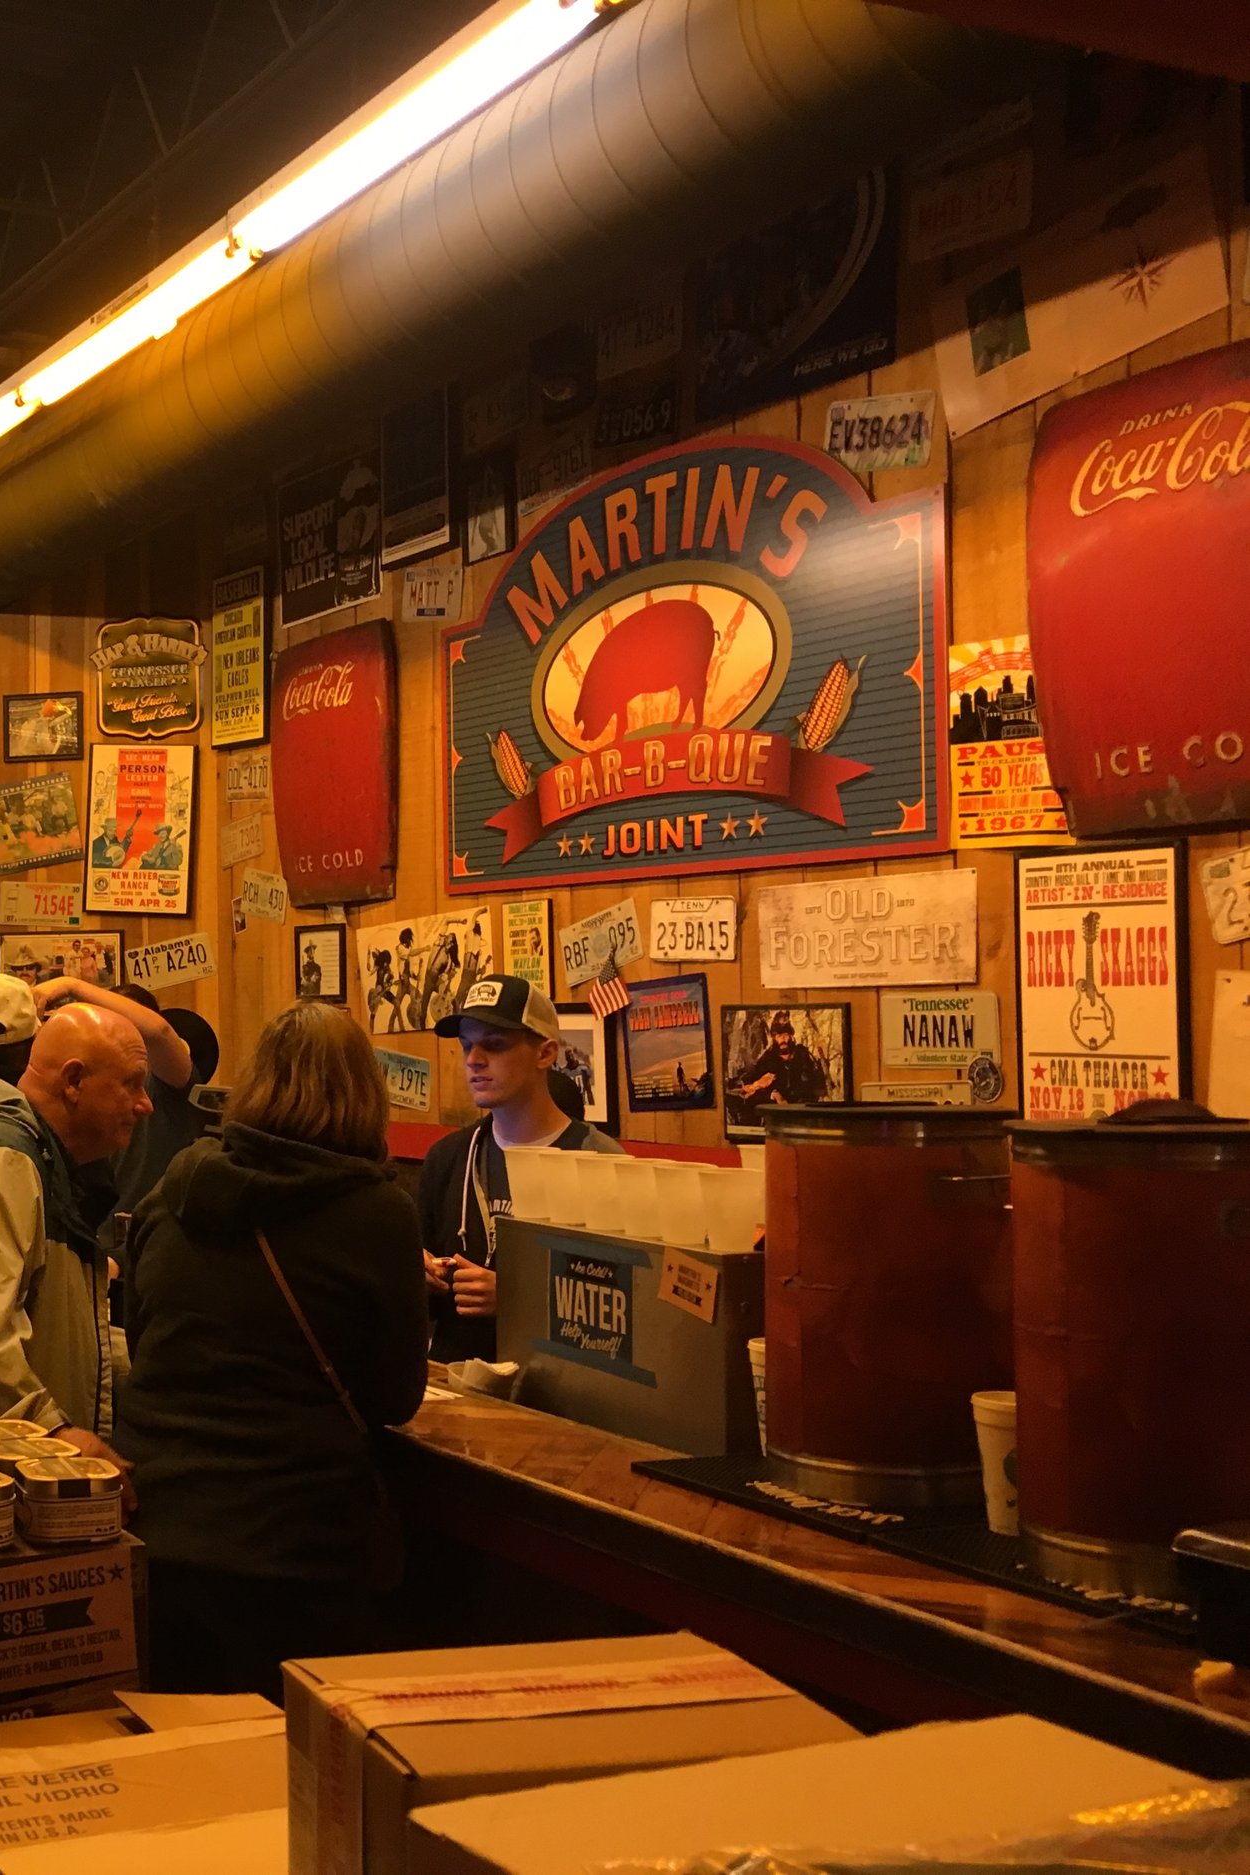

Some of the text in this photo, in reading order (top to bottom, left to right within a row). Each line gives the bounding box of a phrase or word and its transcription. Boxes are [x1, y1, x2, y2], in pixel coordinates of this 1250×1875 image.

[1119, 403, 1193, 436] DRINK
[1070, 401, 1250, 518] Coca-Col
[282, 500, 335, 541] SUPPORT
[506, 464, 828, 645] MARTIN'S
[90, 642, 124, 670] HAP
[126, 634, 147, 657] &
[110, 664, 189, 678] TENNESSEE
[228, 669, 248, 688] EAGLES
[130, 678, 168, 688] LAGER
[282, 661, 355, 721] Coca-Cola
[215, 708, 229, 721] SUN
[231, 705, 249, 718] SEPT
[252, 704, 259, 715] 16
[957, 741, 1044, 761] PAUS
[991, 757, 1042, 766] CELEBRA
[1094, 743, 1154, 781] ICE
[120, 764, 166, 773] PERSON
[556, 734, 773, 811] BAR-B-QUE
[981, 763, 1044, 788] 50 YEARS
[975, 815, 1046, 832] 1967
[603, 813, 709, 858] JOINT
[322, 848, 364, 870] COLD
[1081, 860, 1134, 872] ANNUAL
[112, 871, 158, 880] NEW RIVER
[121, 881, 149, 889] RANCH
[34, 894, 74, 916] 7154E
[114, 898, 177, 908] SUN APR 25
[243, 880, 284, 911] RCH 430
[681, 900, 705, 910] TENN
[825, 885, 894, 922] OLD
[144, 938, 191, 956] Alabama
[564, 936, 589, 971] RBF
[769, 920, 961, 969] FORESTER
[133, 943, 207, 980] 41 A240
[514, 957, 541, 969] WAYLON
[1026, 926, 1168, 987] RICKY SKAGGS
[907, 998, 970, 1011] Tennessee
[903, 1014, 975, 1049] NANAW
[916, 1053, 968, 1063] Volunteer State
[399, 1067, 427, 1096] 197E
[1050, 1059, 1148, 1089] CMA THEATER
[887, 1087, 944, 1098] MISSISSIPPI
[555, 1275, 626, 1335] WATER
[560, 1322, 623, 1360] Help Yourself!
[48, 1565, 105, 1593] SAUCES
[3, 1609, 44, 1635] $6.95
[52, 1635, 85, 1651] DEVIL'S
[33, 1654, 79, 1673] PALMETTO
[22, 1764, 115, 1787] VERRE
[25, 1783, 120, 1804] VIDRIO
[59, 1807, 115, 1824] MADE
[0, 1832, 20, 1845] IN
